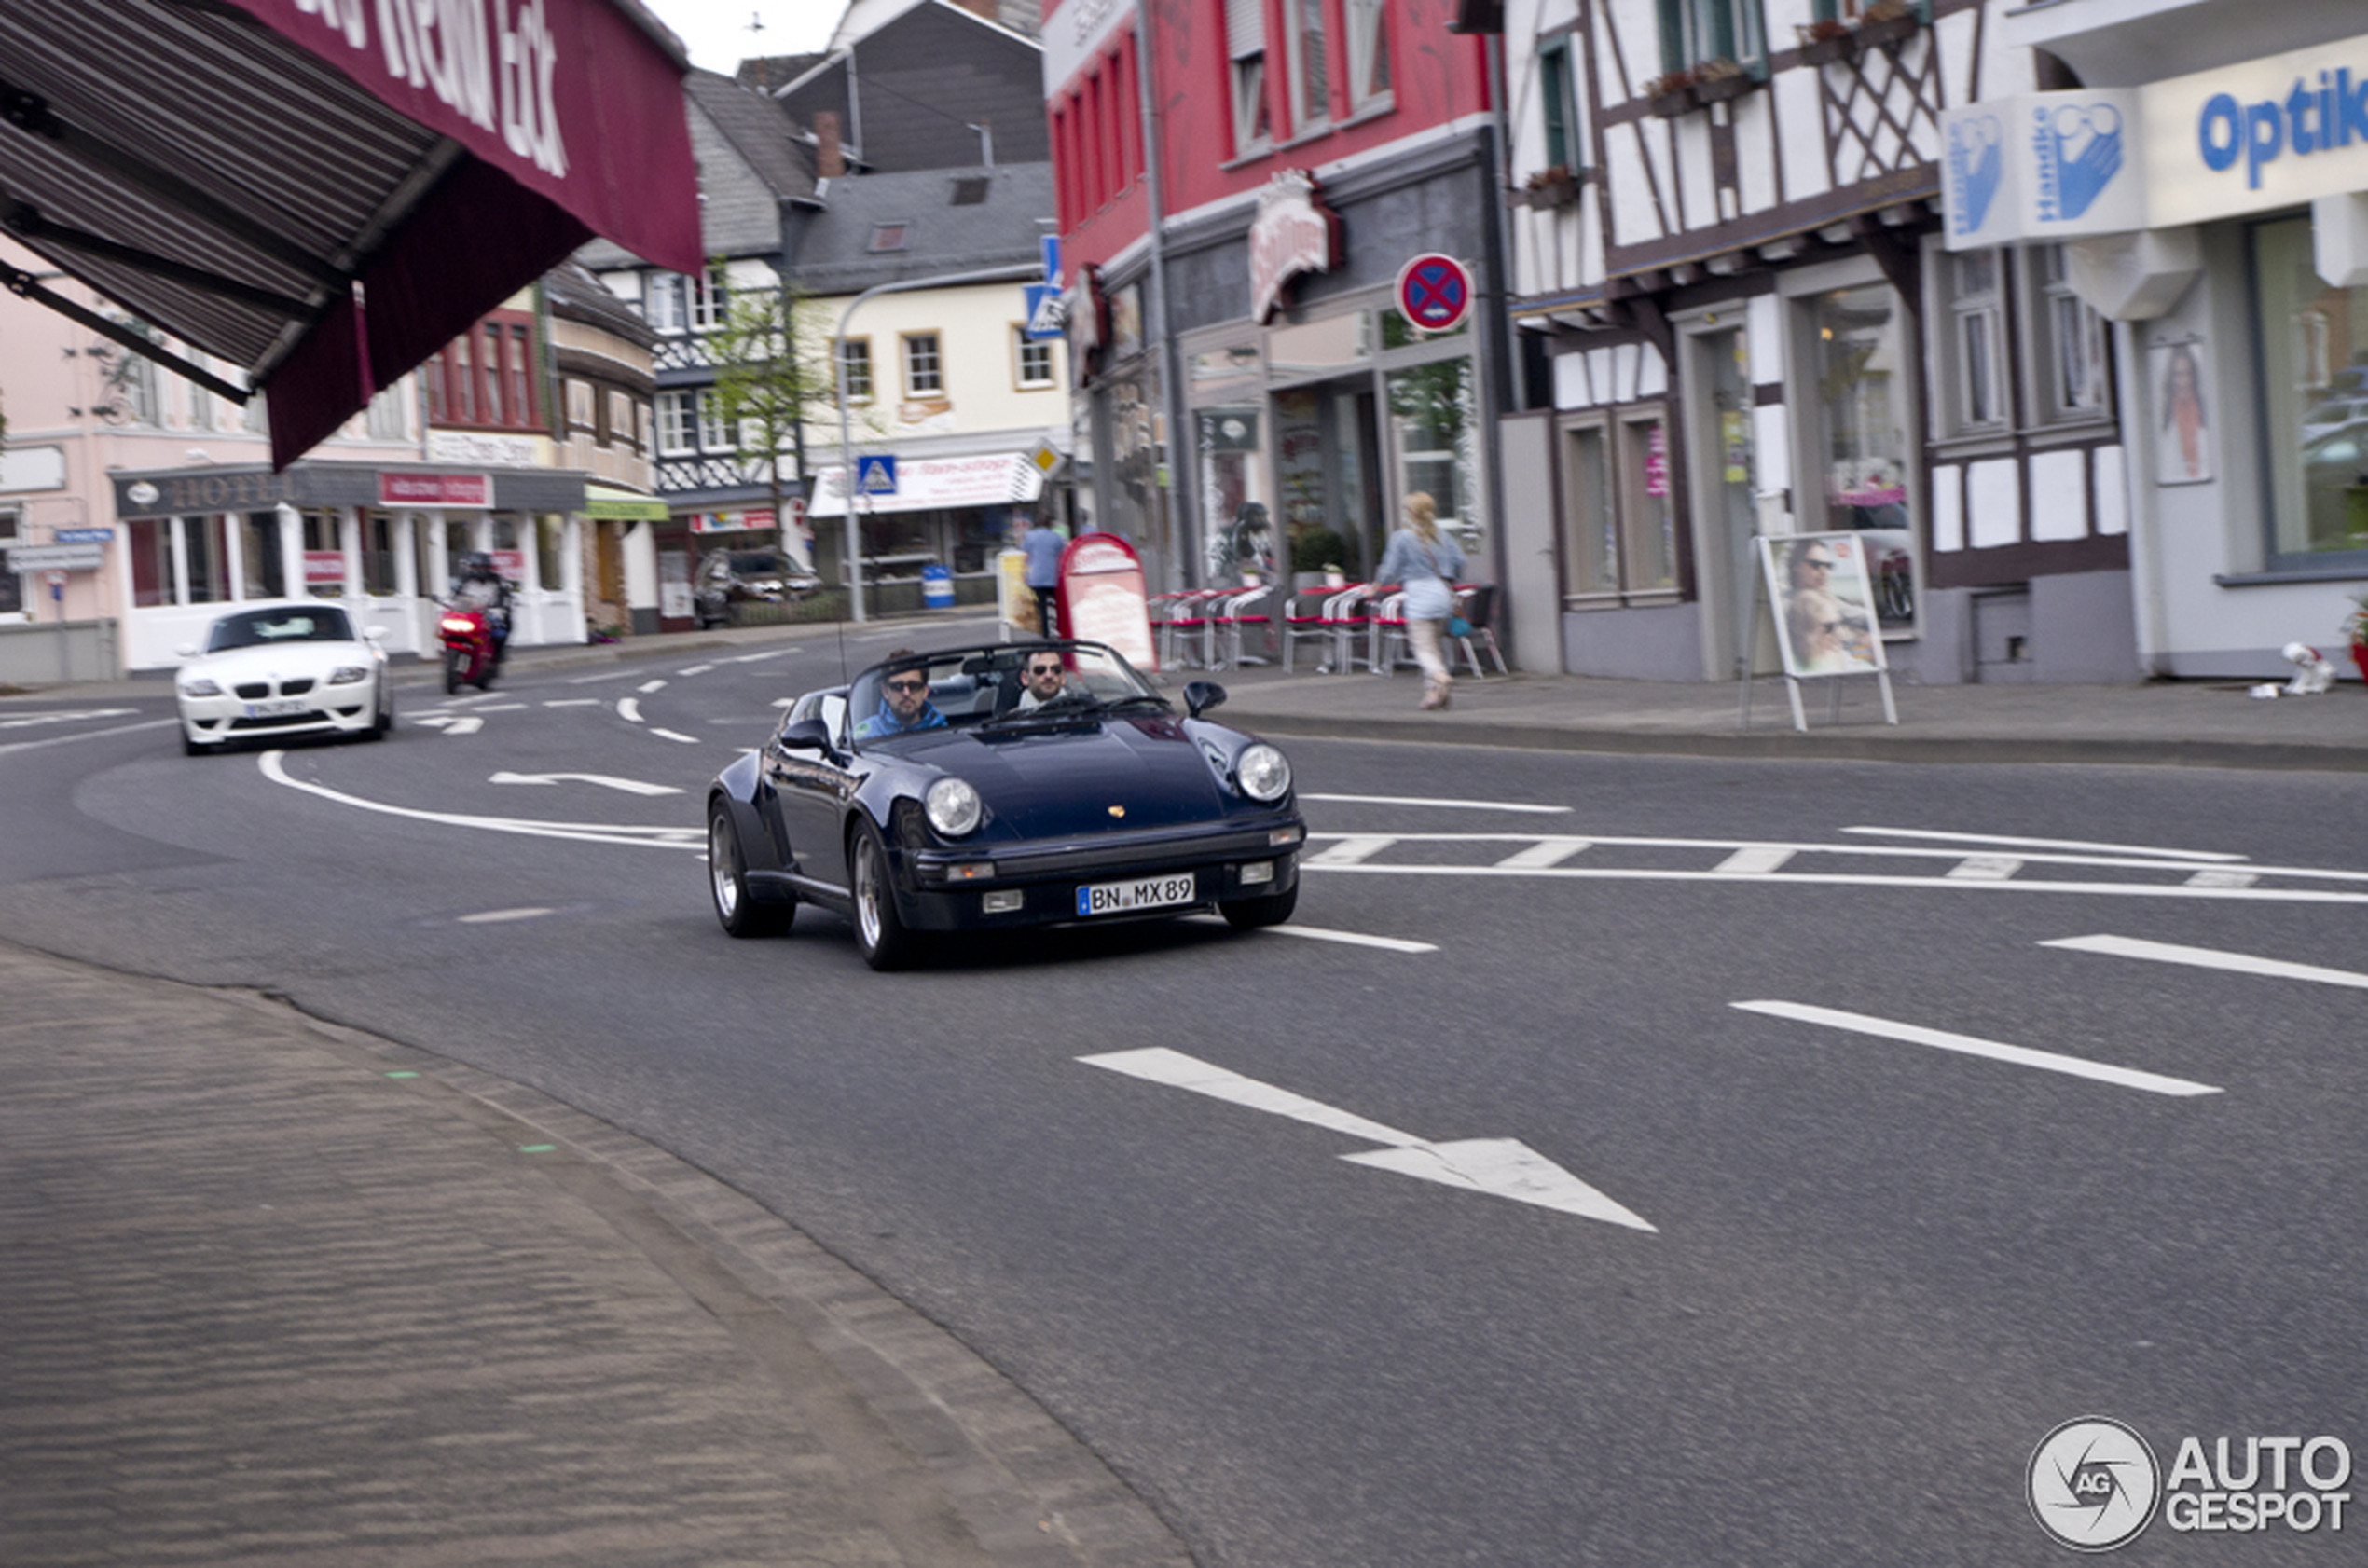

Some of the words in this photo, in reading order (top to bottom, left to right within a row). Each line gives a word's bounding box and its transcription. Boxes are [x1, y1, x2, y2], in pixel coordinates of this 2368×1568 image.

[2198, 66, 2368, 191] Optik
[1091, 887, 1120, 911] BN
[1135, 882, 1163, 905] MX
[1165, 878, 1191, 901] 89
